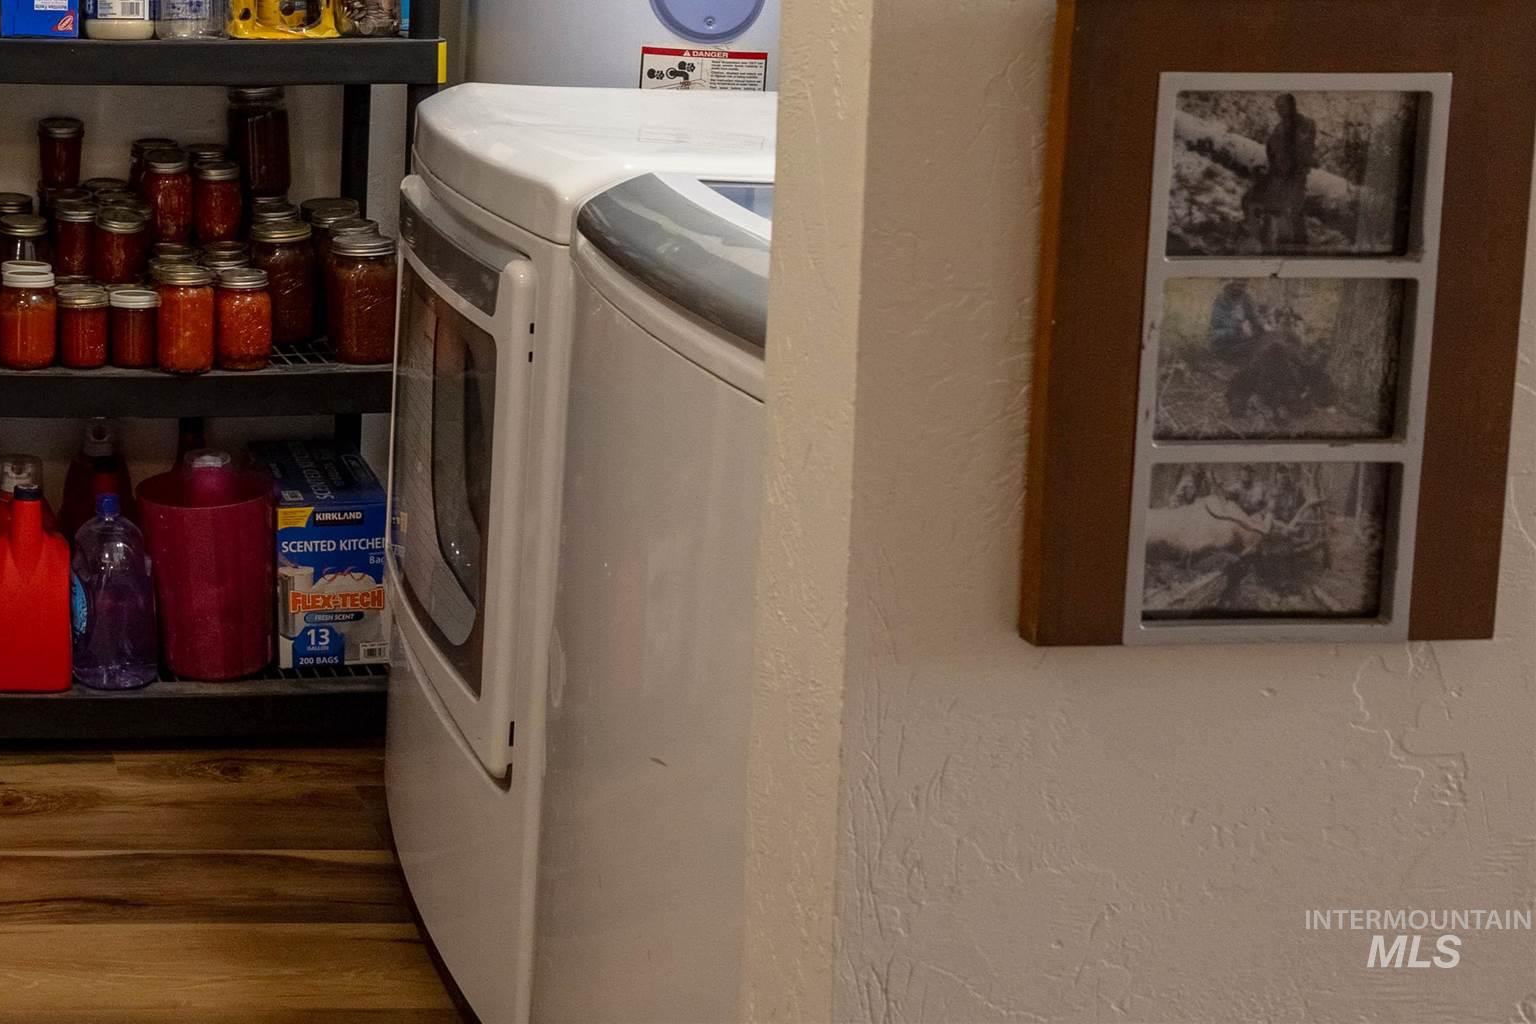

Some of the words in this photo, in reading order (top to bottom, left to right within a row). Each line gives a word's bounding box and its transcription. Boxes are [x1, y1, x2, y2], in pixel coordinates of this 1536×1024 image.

[315, 511, 363, 521] KIRKLAND
[281, 540, 337, 553] SCENTED
[335, 613, 354, 621] SCENT
[306, 628, 330, 646] 13
[299, 657, 314, 665] 200
[316, 656, 340, 664] BAGS
